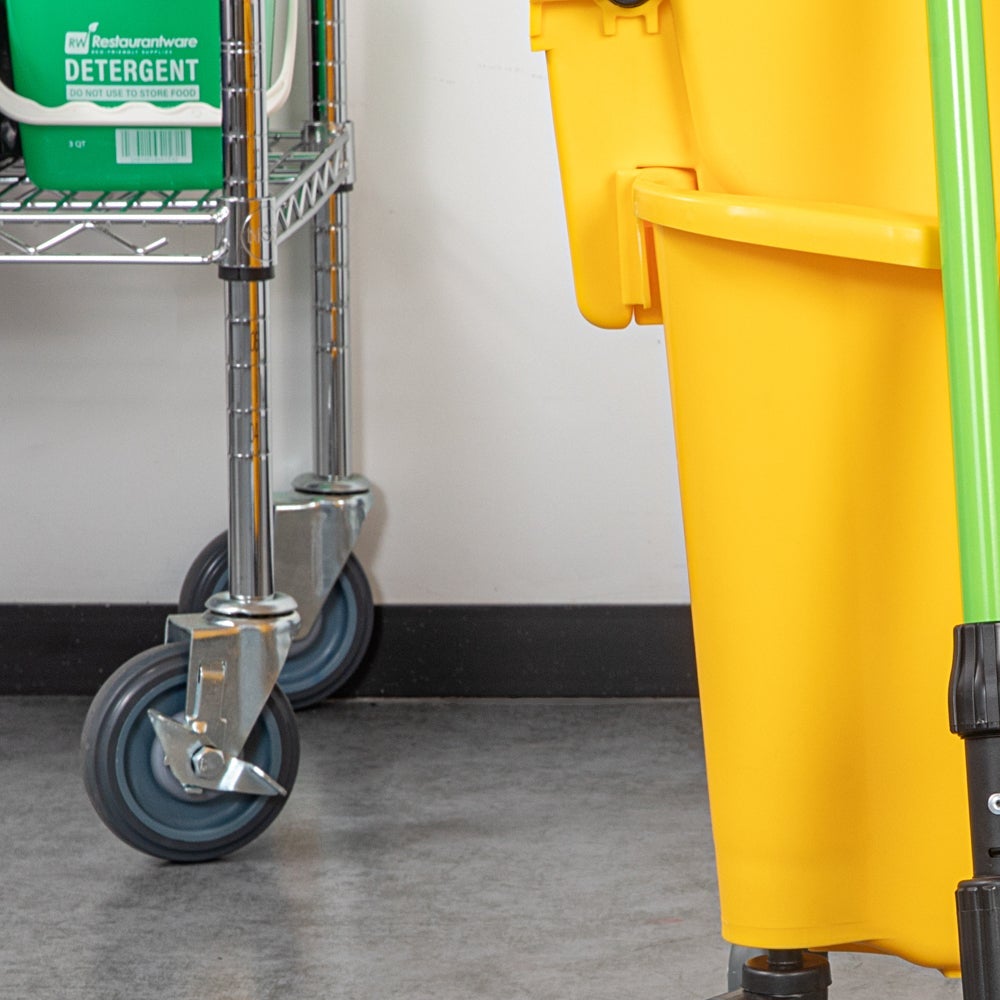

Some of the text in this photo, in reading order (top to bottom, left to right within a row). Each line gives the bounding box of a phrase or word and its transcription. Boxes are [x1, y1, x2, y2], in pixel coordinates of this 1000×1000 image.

[92, 35, 198, 48] Restaurantware
[65, 59, 199, 82] DETERGENT
[70, 88, 196, 97] DO NOT USE TO STORE FOOD
[75, 140, 86, 149] QT
